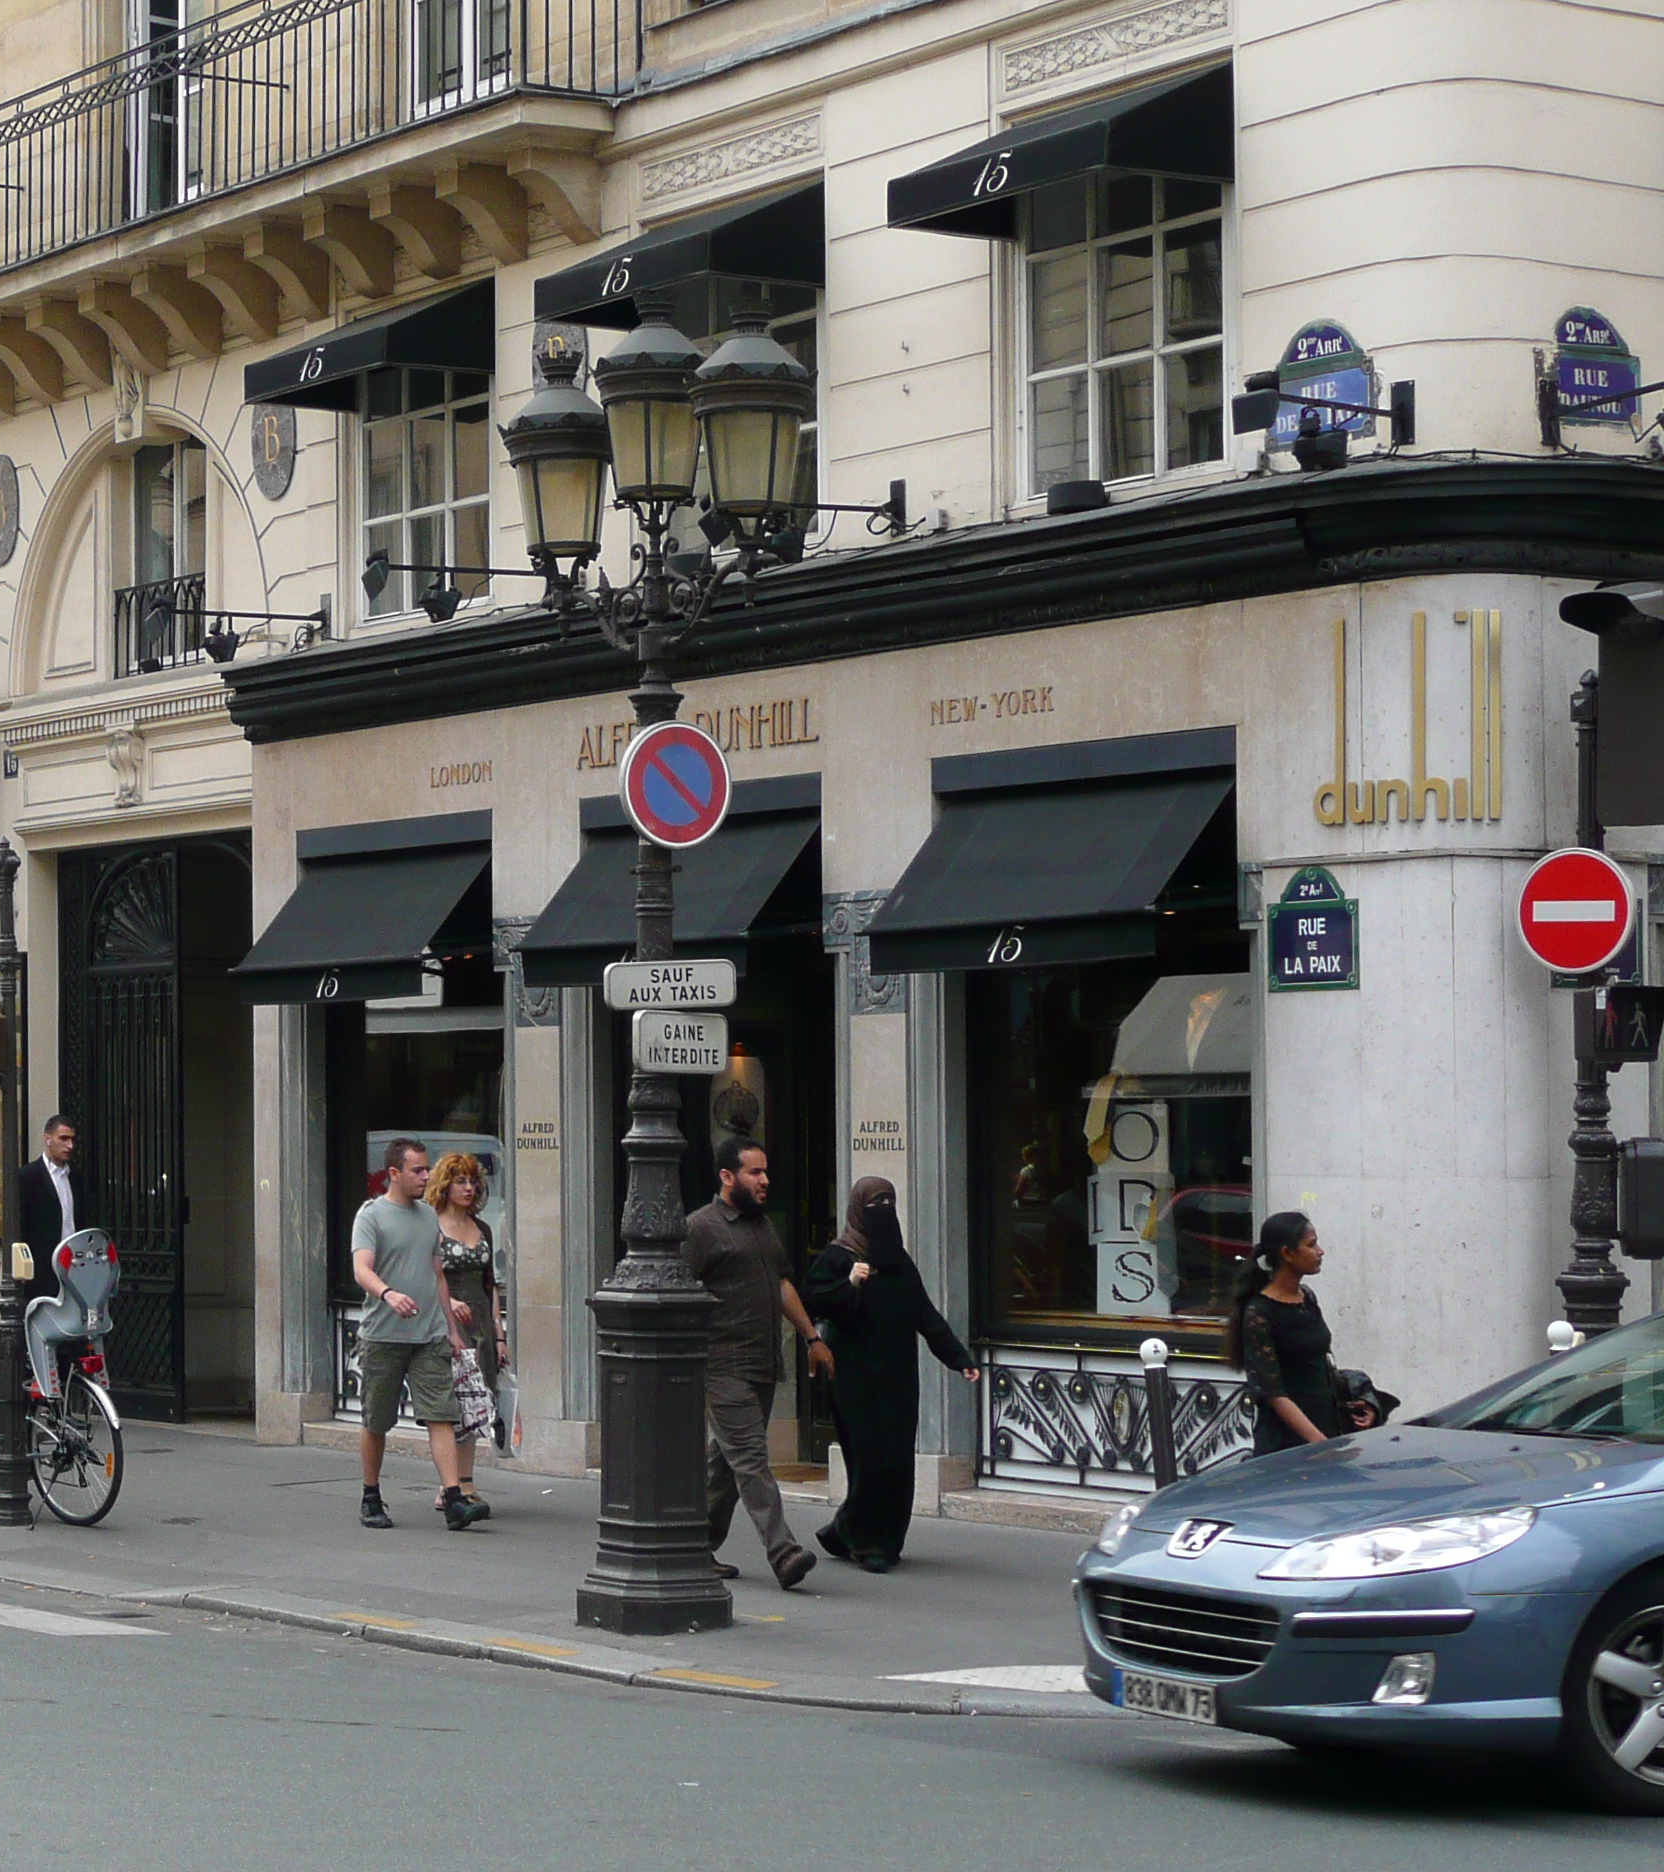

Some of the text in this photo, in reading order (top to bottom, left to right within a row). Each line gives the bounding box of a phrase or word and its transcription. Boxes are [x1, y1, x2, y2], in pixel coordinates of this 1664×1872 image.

[973, 149, 1013, 197] 15
[601, 255, 633, 296] 15
[299, 344, 325, 382] 15
[1574, 368, 1608, 388] RUE
[1301, 381, 1336, 399] RUE
[1276, 414, 1298, 434] DE
[264, 415, 280, 462] B
[930, 686, 1055, 726] NEW-YORK
[695, 697, 819, 753] DUNHILL
[1313, 608, 1502, 825] dunhill
[430, 759, 493, 788] LONDON
[1298, 917, 1326, 936] RUE
[987, 925, 1025, 963] 15
[1307, 941, 1317, 951] DE
[1284, 955, 1341, 974] LA PAIX
[316, 967, 340, 999] 15
[651, 968, 694, 983] SAUF
[629, 985, 717, 1003] AUX TAXIS
[664, 1024, 705, 1041] GAINE
[648, 1047, 719, 1065] INTERDITE
[522, 1122, 555, 1134] ALFRED
[859, 1121, 900, 1133] ALFRED
[517, 1138, 559, 1150] DUNHILL
[853, 1138, 905, 1151] DUNHILL
[1190, 1688, 1212, 1720] 75
